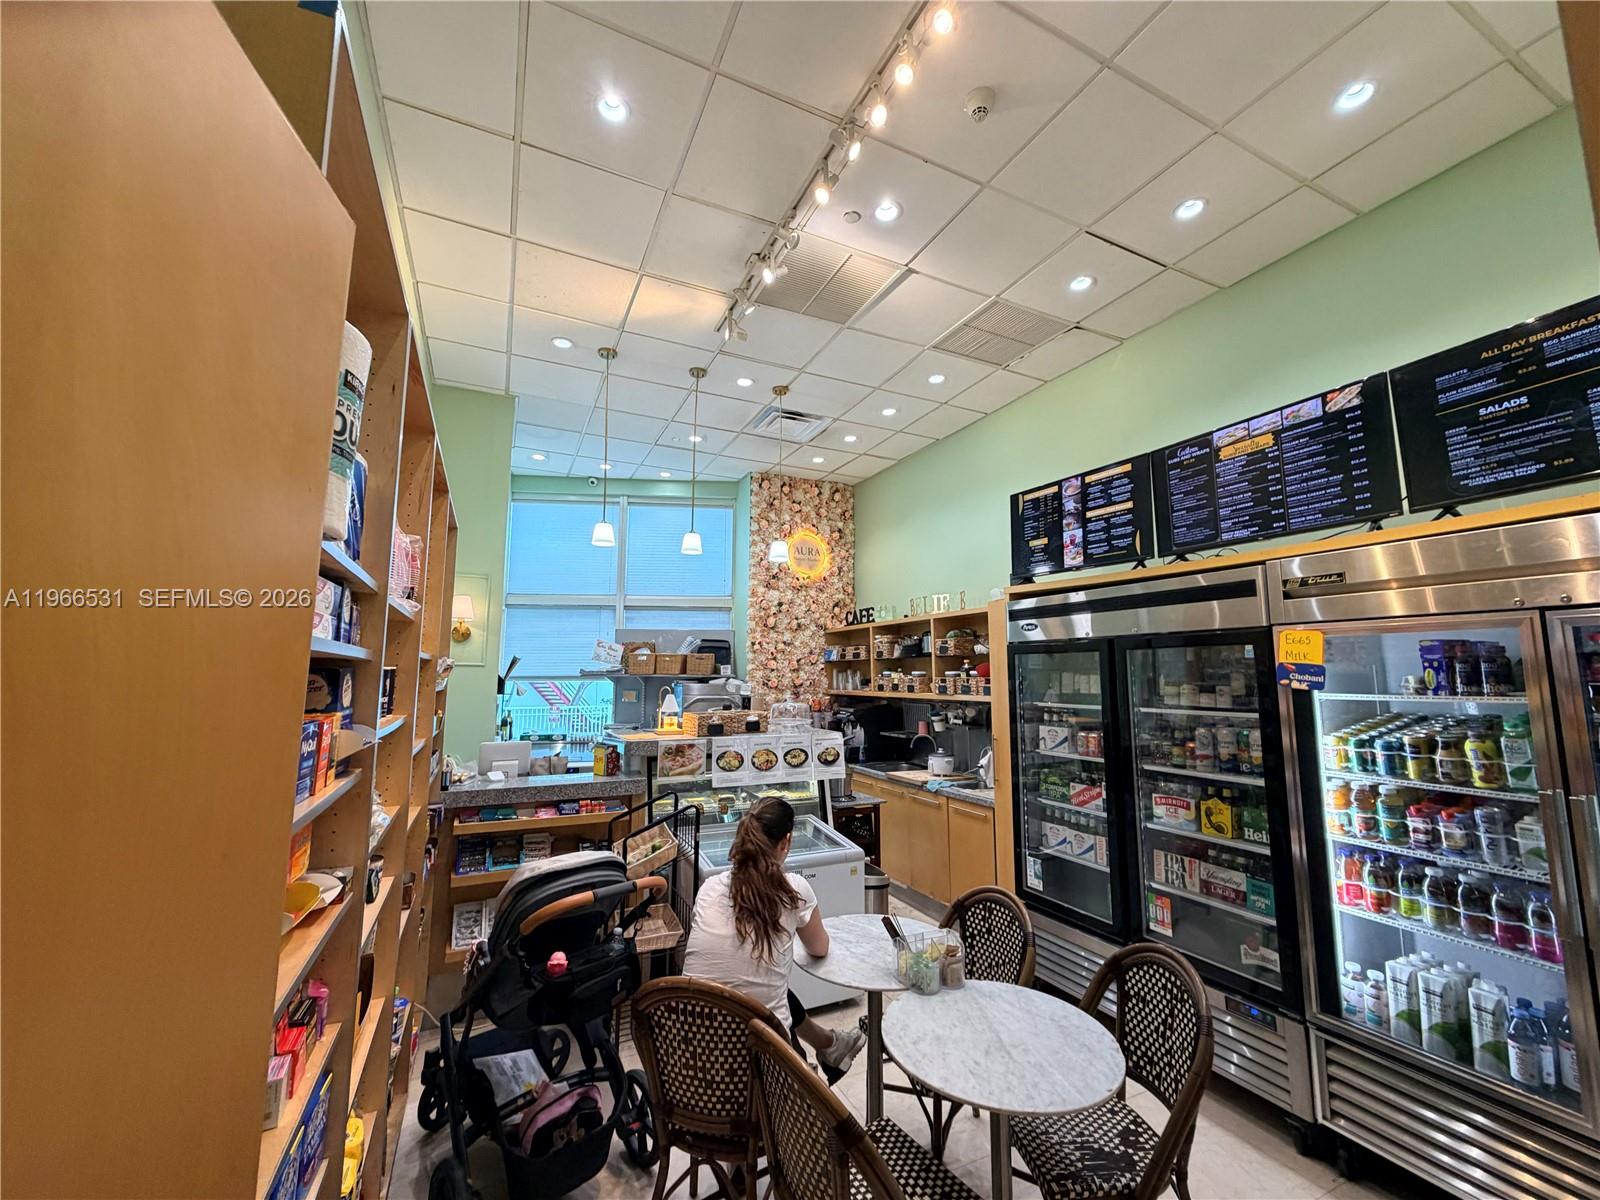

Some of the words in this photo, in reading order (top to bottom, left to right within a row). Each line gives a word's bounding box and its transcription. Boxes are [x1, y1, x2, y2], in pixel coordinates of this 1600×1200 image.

[1480, 348, 1501, 359] ALL
[1502, 337, 1527, 353] DAY
[1478, 396, 1528, 416] SALADS
[794, 545, 821, 557] AURA
[845, 606, 875, 625] CAFE
[1285, 634, 1312, 645] EGGS
[1285, 650, 1310, 661] MILK
[1289, 672, 1325, 684] Chobani
[1156, 796, 1188, 808] SMIRNOFF
[1165, 806, 1179, 815] ICE
[1211, 885, 1236, 899] LAGER
